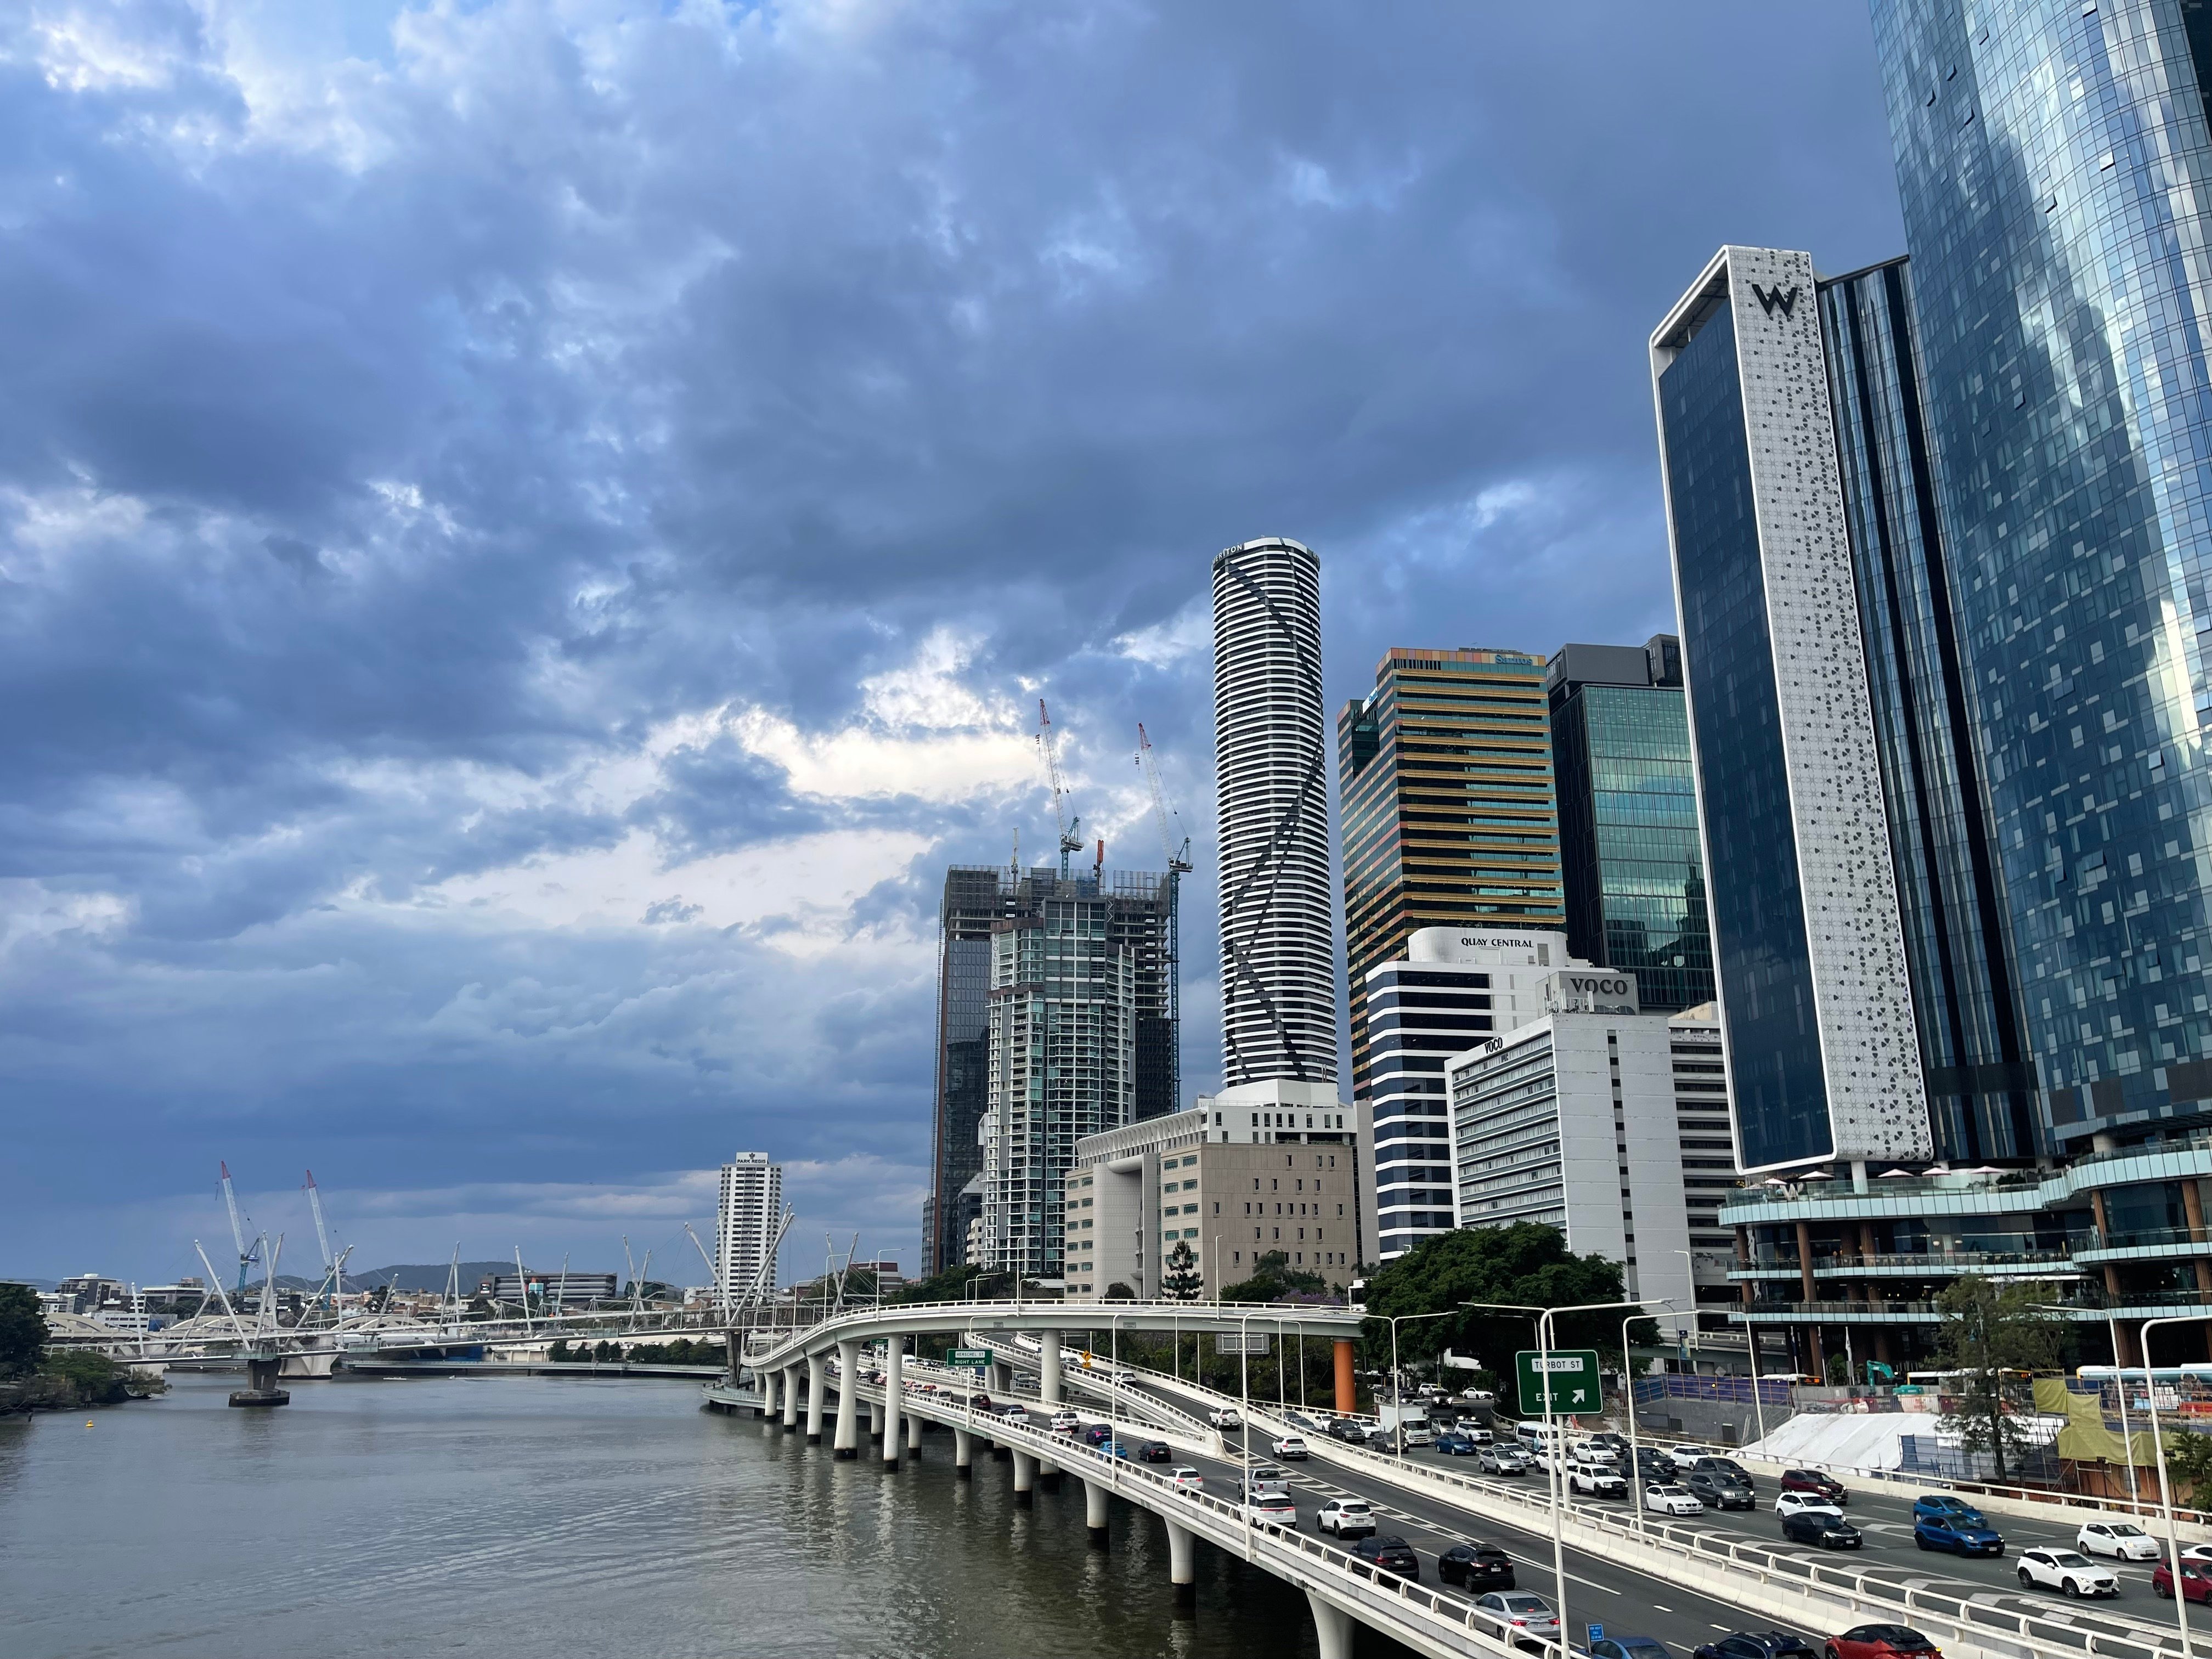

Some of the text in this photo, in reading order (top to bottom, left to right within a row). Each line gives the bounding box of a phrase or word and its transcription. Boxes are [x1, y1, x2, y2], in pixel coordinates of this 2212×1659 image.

[1752, 284, 1798, 317] W
[1495, 653, 1533, 665] Santos
[1461, 937, 1534, 948] QUAY CENTRAL
